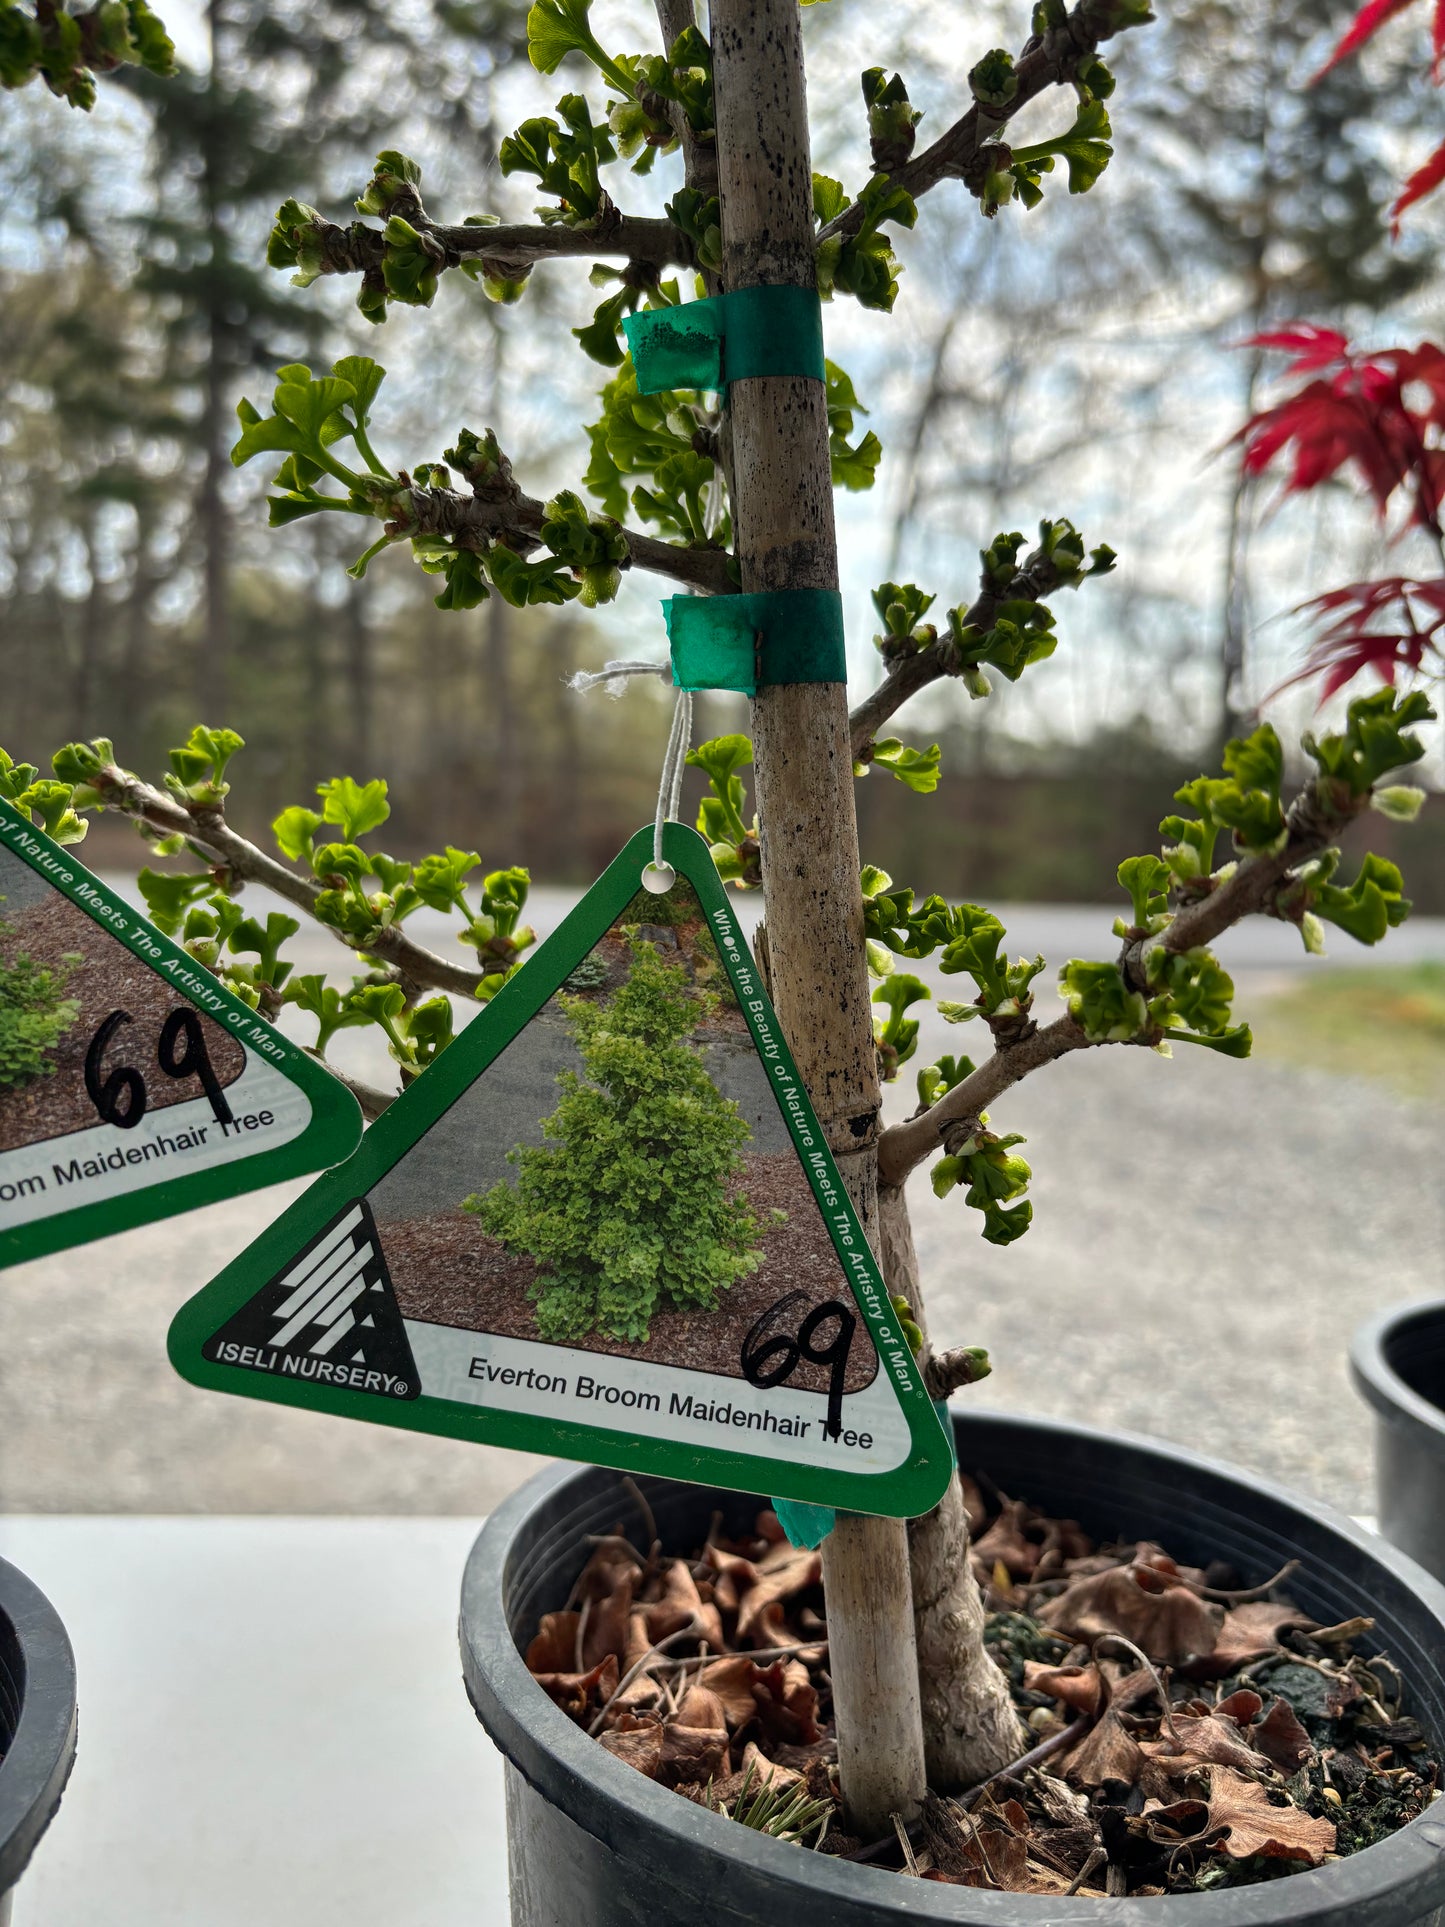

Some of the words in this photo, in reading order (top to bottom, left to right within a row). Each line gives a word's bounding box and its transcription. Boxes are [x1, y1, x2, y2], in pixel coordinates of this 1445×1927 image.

[13, 832, 74, 884] Nature
[74, 882, 129, 930] Meets
[129, 927, 163, 960] The
[161, 959, 228, 1011] Artistry
[227, 1012, 252, 1027] of
[247, 1027, 286, 1060] Man
[713, 908, 741, 963] Whre
[735, 966, 753, 996] the
[749, 1000, 780, 1060] Beauty
[85, 1007, 234, 1128] 69
[775, 1065, 792, 1083] of
[783, 1087, 814, 1147] Nature
[52, 1127, 207, 1186] Maidenhair
[808, 1152, 838, 1208] Meets
[833, 1211, 853, 1246] The
[847, 1252, 883, 1320] Artistry
[216, 1341, 278, 1370] ISELI
[741, 1288, 856, 1438] 69
[879, 1326, 899, 1344] of
[468, 1356, 567, 1394] Everton
[575, 1375, 660, 1411] Broom
[669, 1392, 811, 1439] Maidenhair
